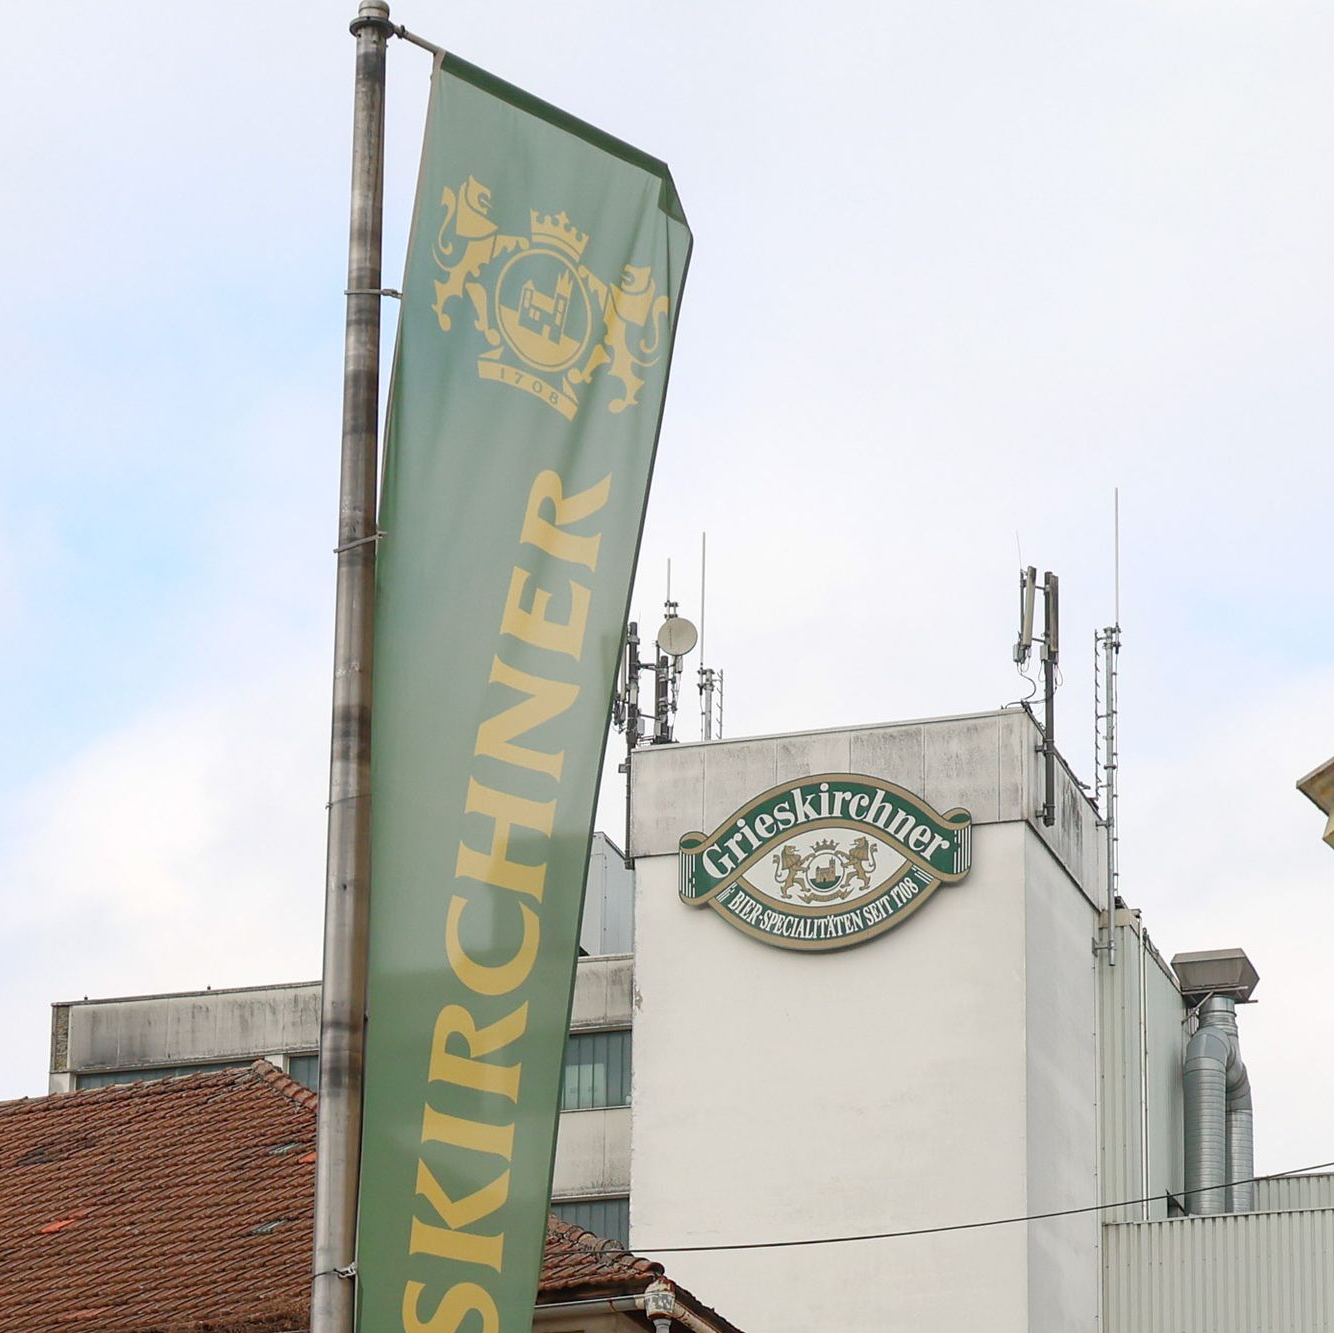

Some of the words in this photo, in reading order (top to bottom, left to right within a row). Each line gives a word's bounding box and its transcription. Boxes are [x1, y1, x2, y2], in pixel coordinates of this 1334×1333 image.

[499, 367, 559, 405] 1708
[701, 782, 950, 879] Grieskirchner
[728, 890, 863, 938] BIER-SPECIALITÄTEN
[864, 902, 892, 926] SEIT
[890, 876, 919, 908] 1708
